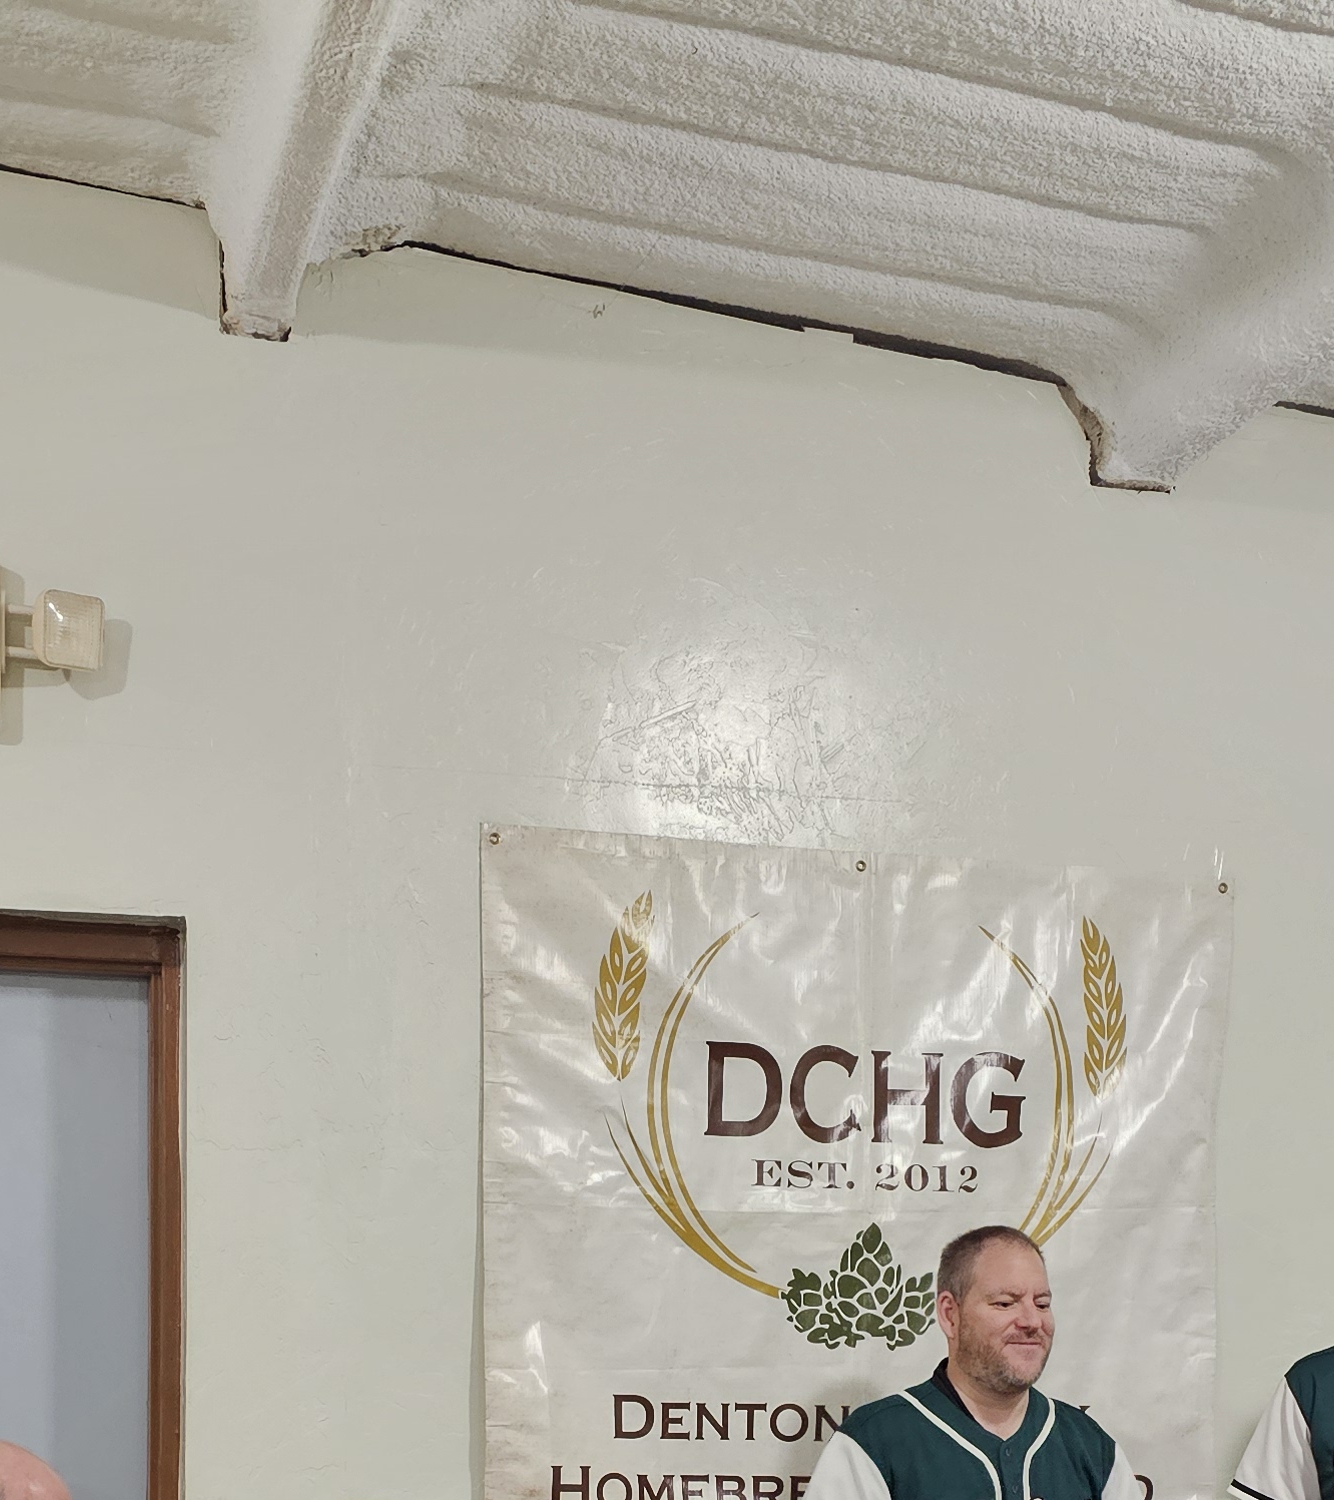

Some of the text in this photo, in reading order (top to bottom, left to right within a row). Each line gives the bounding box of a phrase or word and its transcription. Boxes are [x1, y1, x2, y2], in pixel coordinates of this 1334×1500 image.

[704, 1040, 1027, 1148] DCHG
[751, 1158, 980, 1194] EST. 2012
[612, 1394, 850, 1442] DENTON
